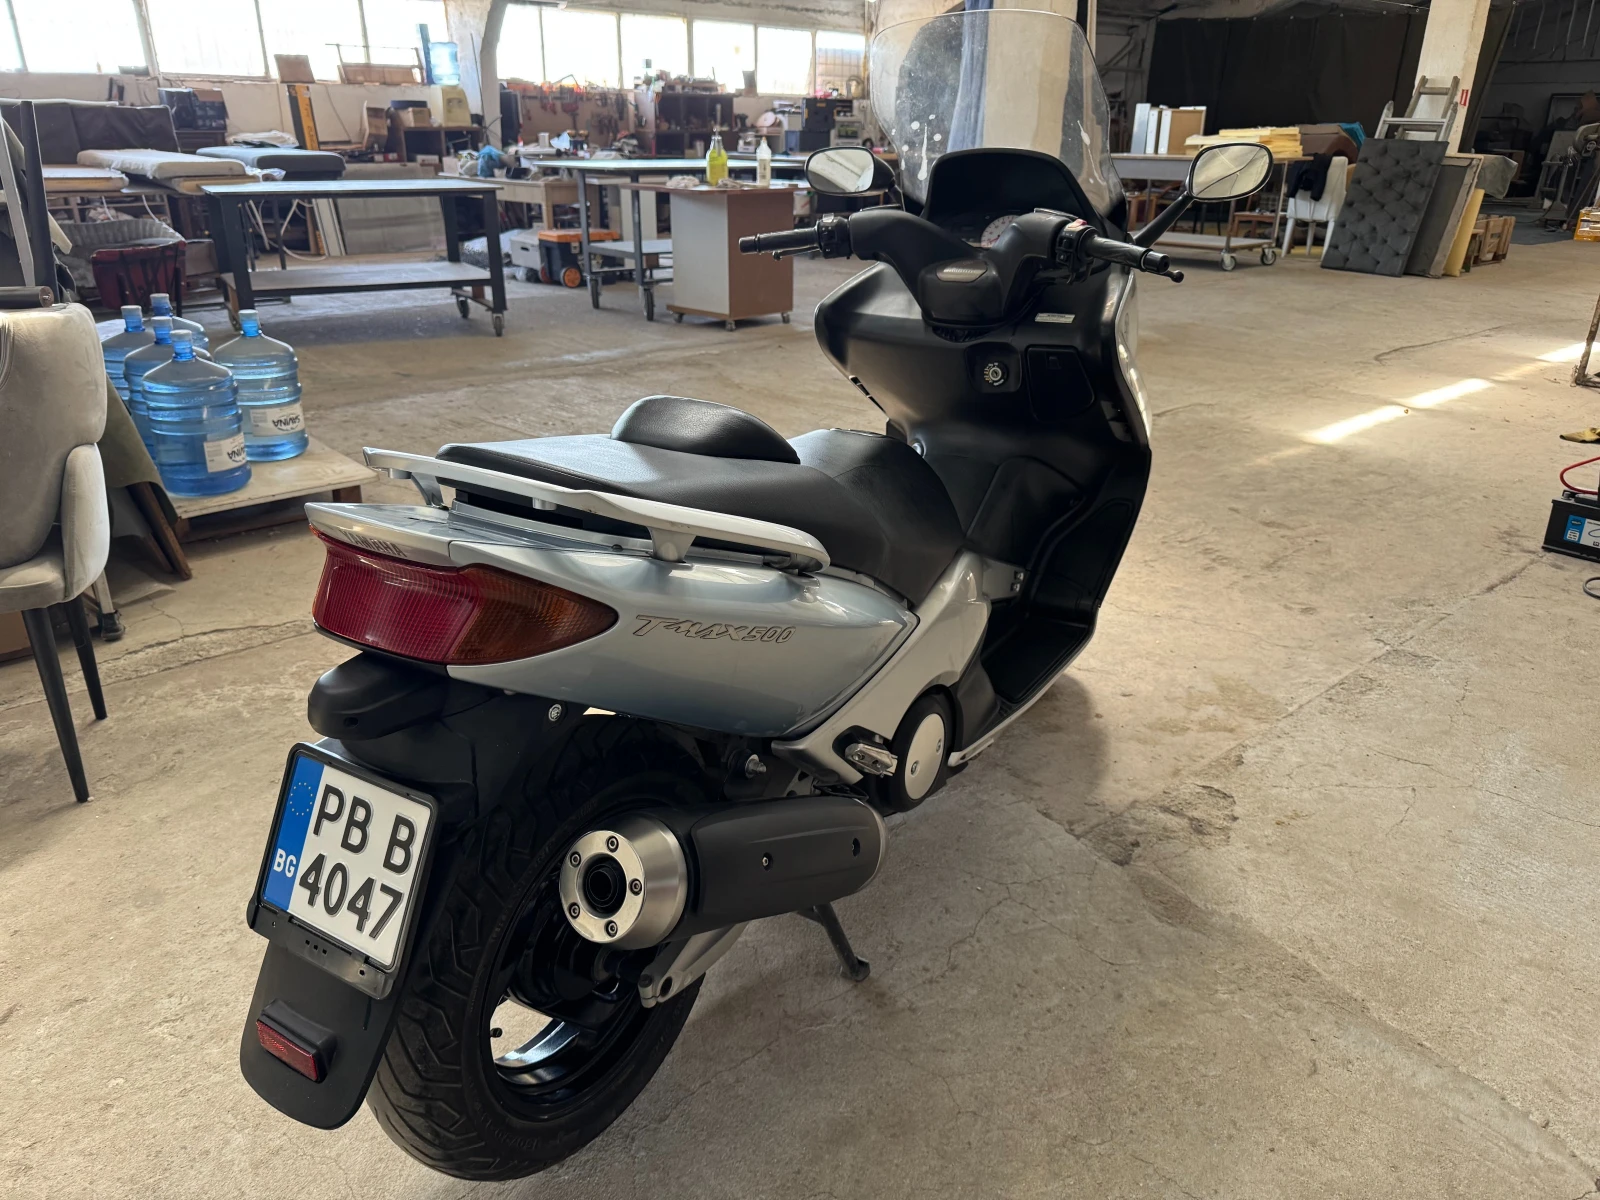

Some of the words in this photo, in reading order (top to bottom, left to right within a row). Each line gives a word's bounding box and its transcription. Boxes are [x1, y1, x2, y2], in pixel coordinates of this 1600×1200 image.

[272, 415, 301, 427] SAVINA
[339, 529, 408, 558] YAMAHA
[313, 783, 374, 855] PB
[383, 813, 416, 876] B
[273, 848, 297, 878] BG
[298, 853, 404, 941] 4047
